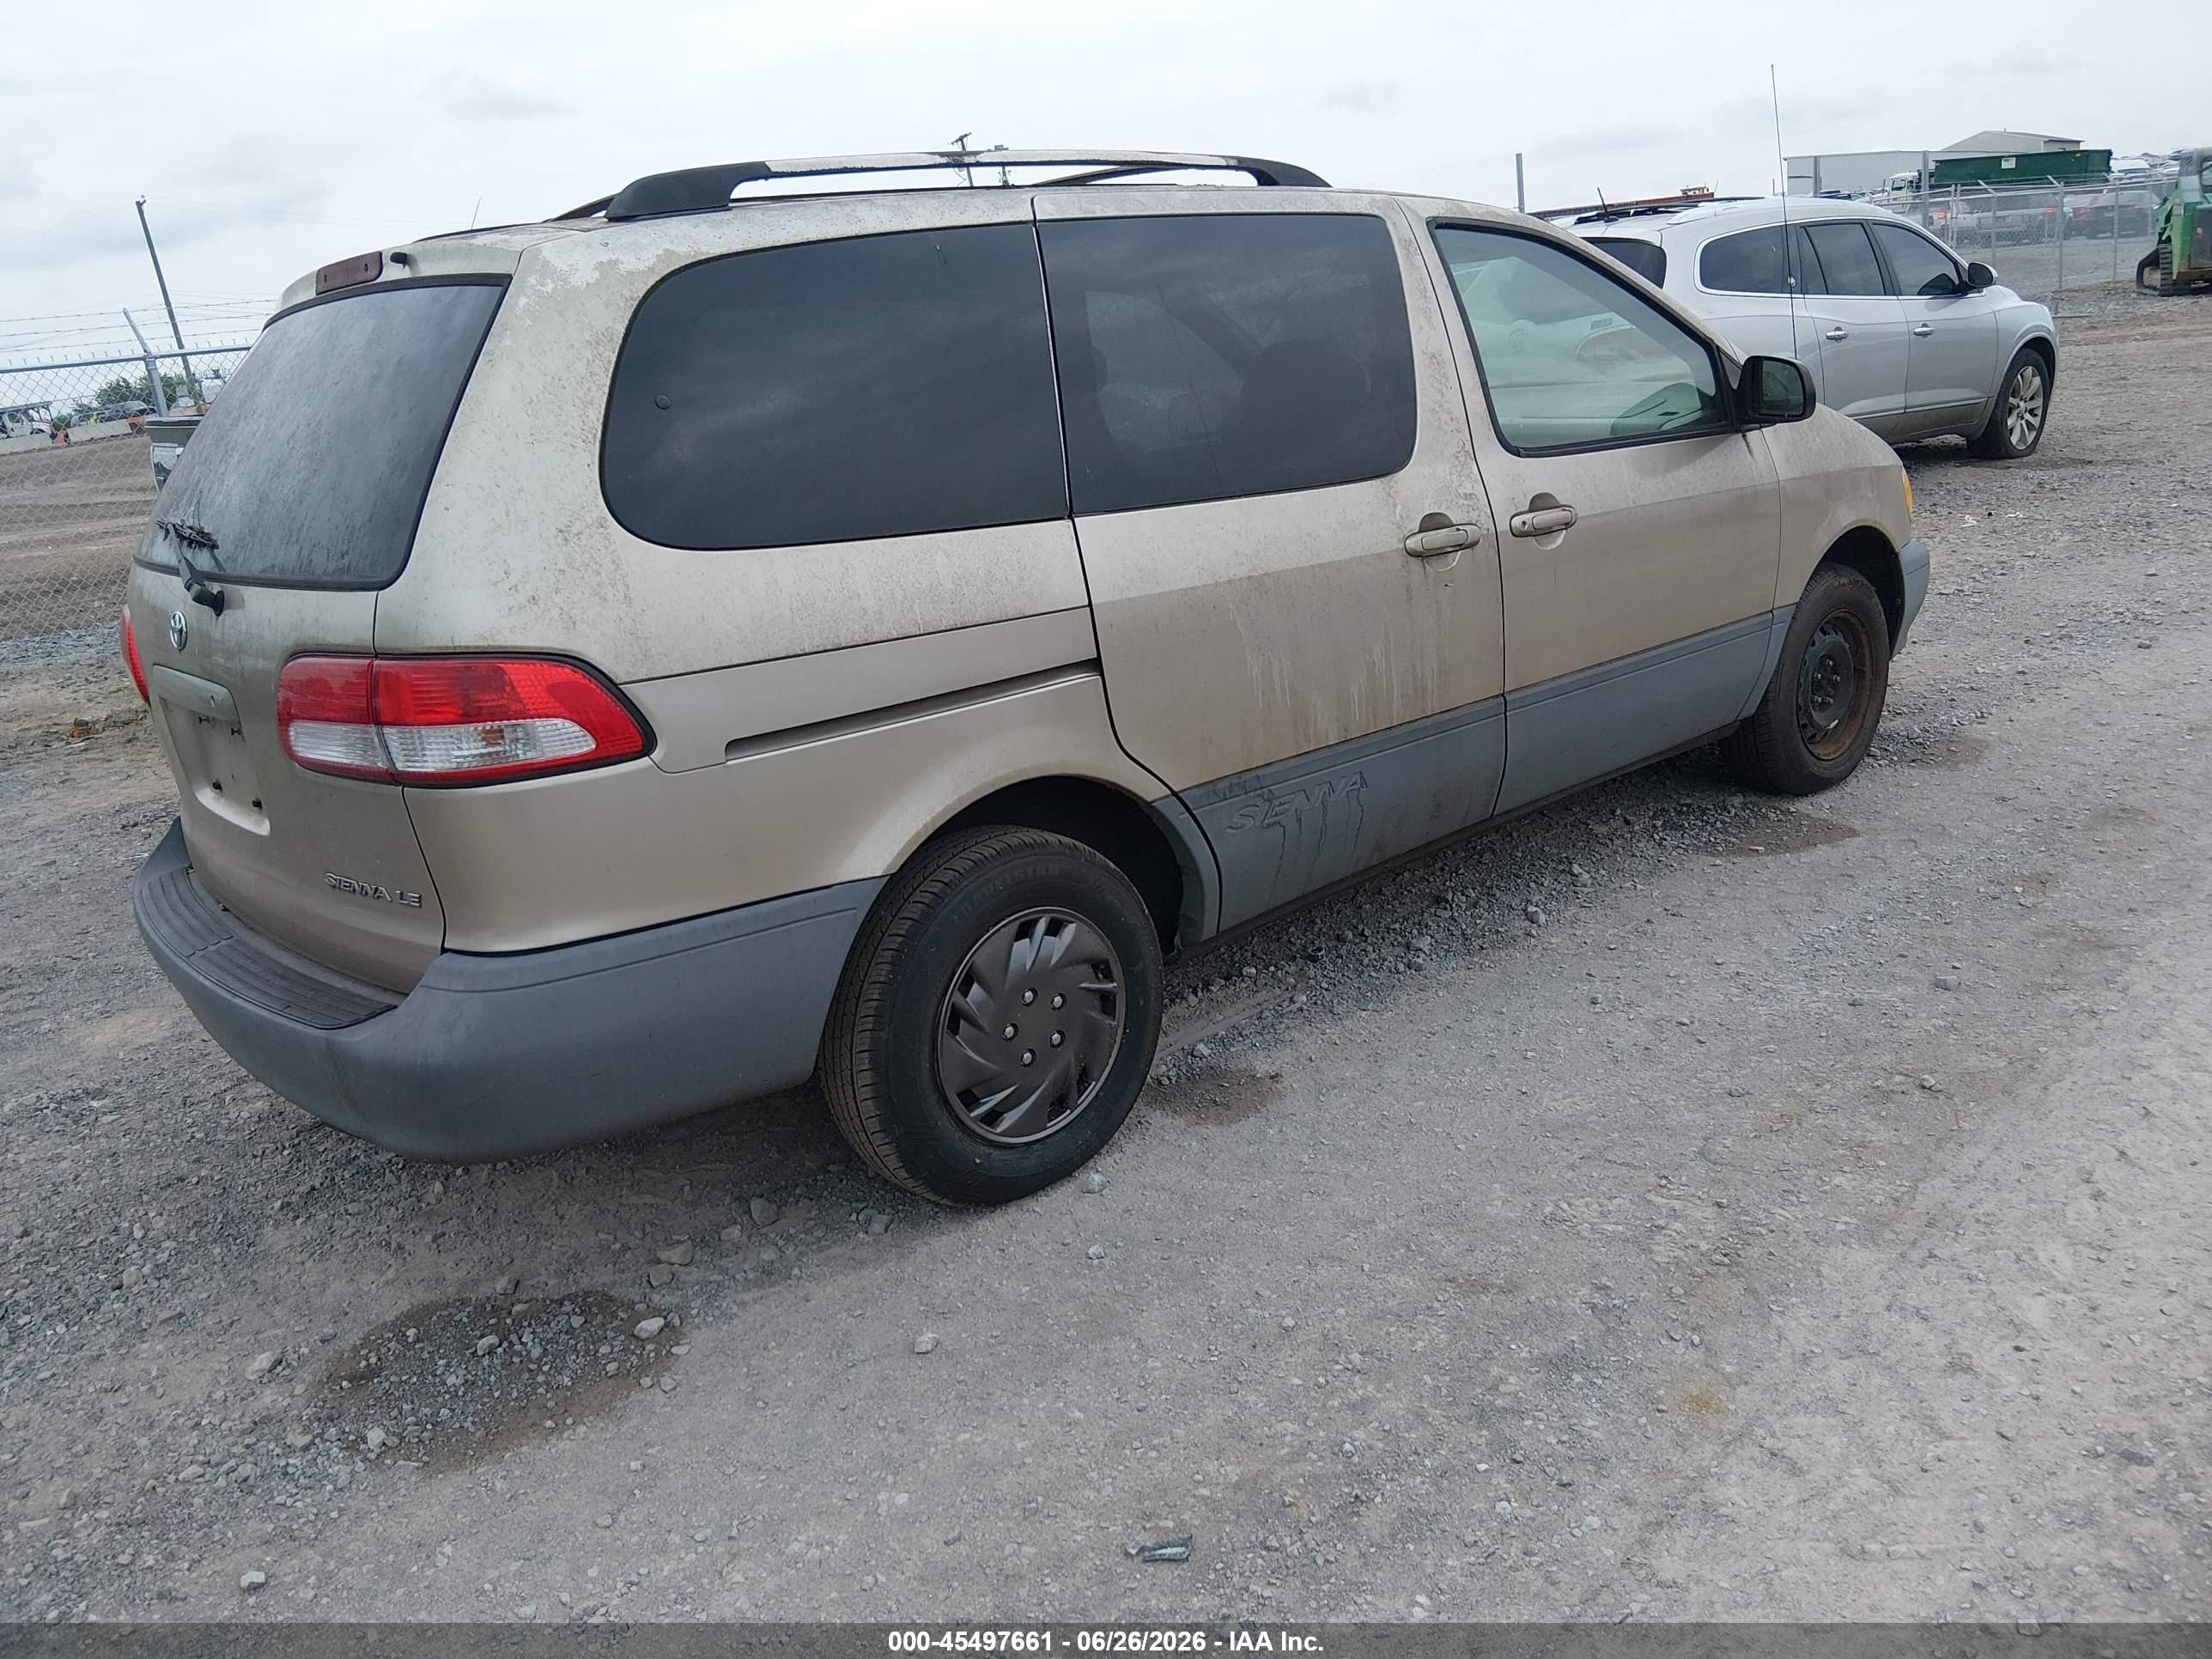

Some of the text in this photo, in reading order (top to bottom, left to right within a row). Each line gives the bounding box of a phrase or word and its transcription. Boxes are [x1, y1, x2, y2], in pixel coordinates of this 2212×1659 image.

[1225, 770, 1368, 833] SIENNA
[324, 872, 422, 908] SIENNA LE
